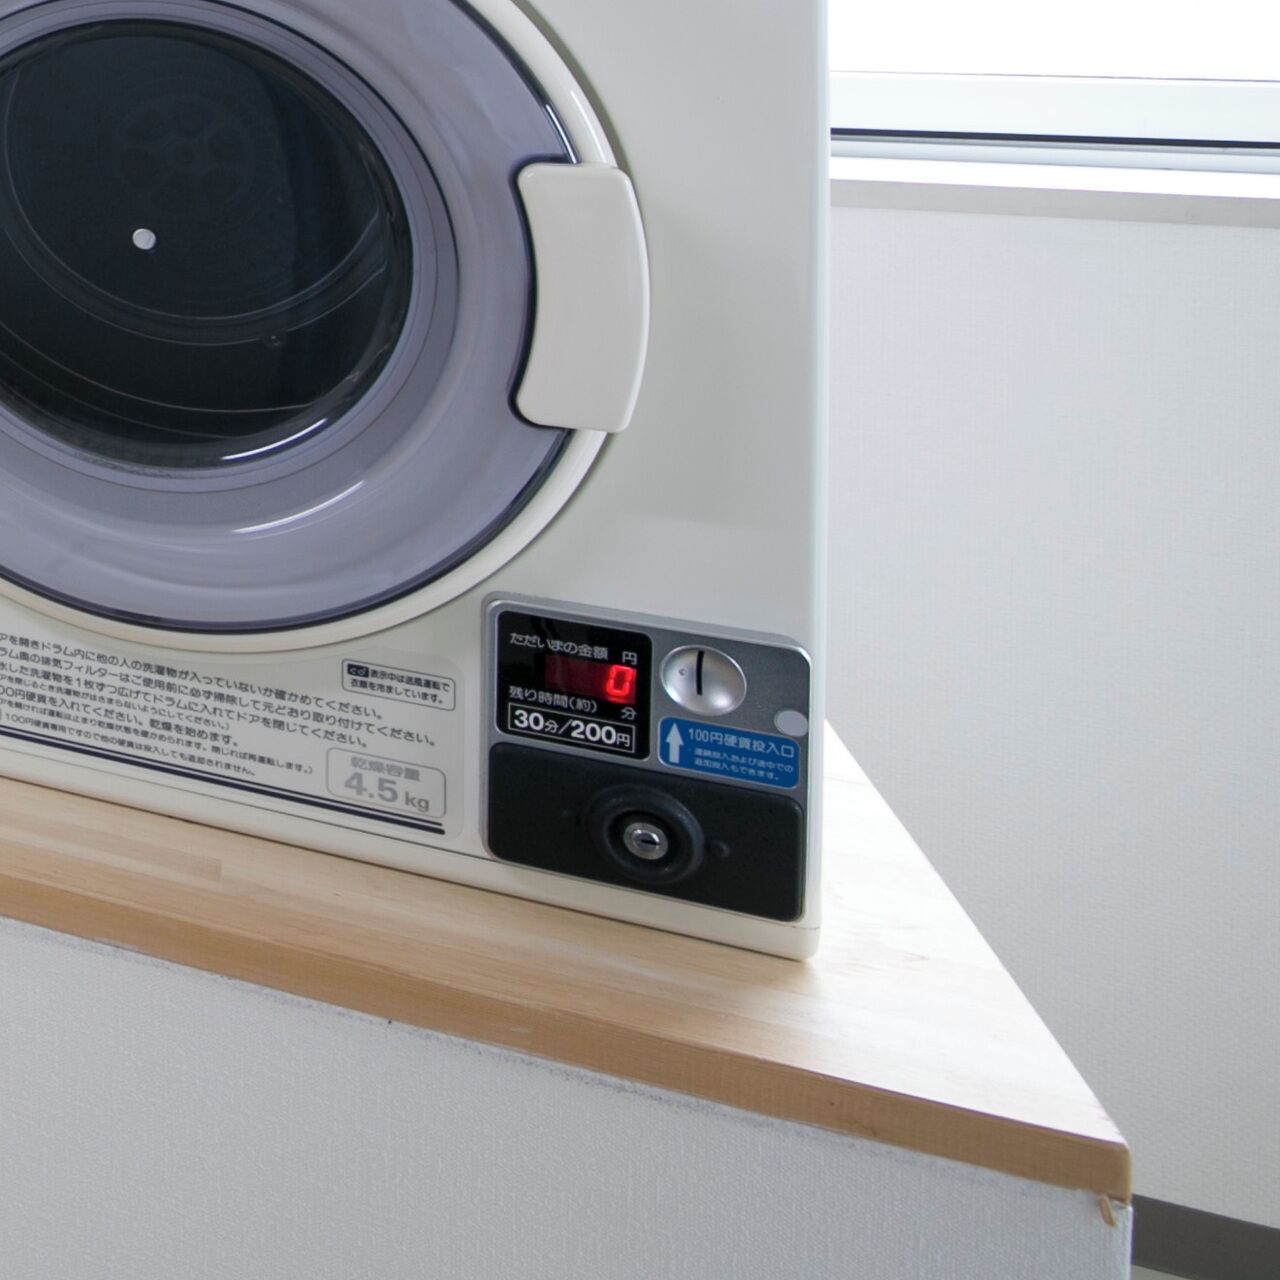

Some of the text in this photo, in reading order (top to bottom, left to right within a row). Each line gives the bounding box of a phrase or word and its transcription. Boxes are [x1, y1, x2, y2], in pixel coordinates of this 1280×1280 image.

[509, 632, 637, 665] ただいまの金額 円
[606, 664, 633, 697] 0
[509, 685, 637, 720] 残り時間(約) 分
[514, 710, 630, 747] 30分/200円
[688, 727, 794, 758] 100円硬貨投入口
[351, 756, 421, 781] 乾燥容量
[344, 772, 429, 812] 4.5 kg
